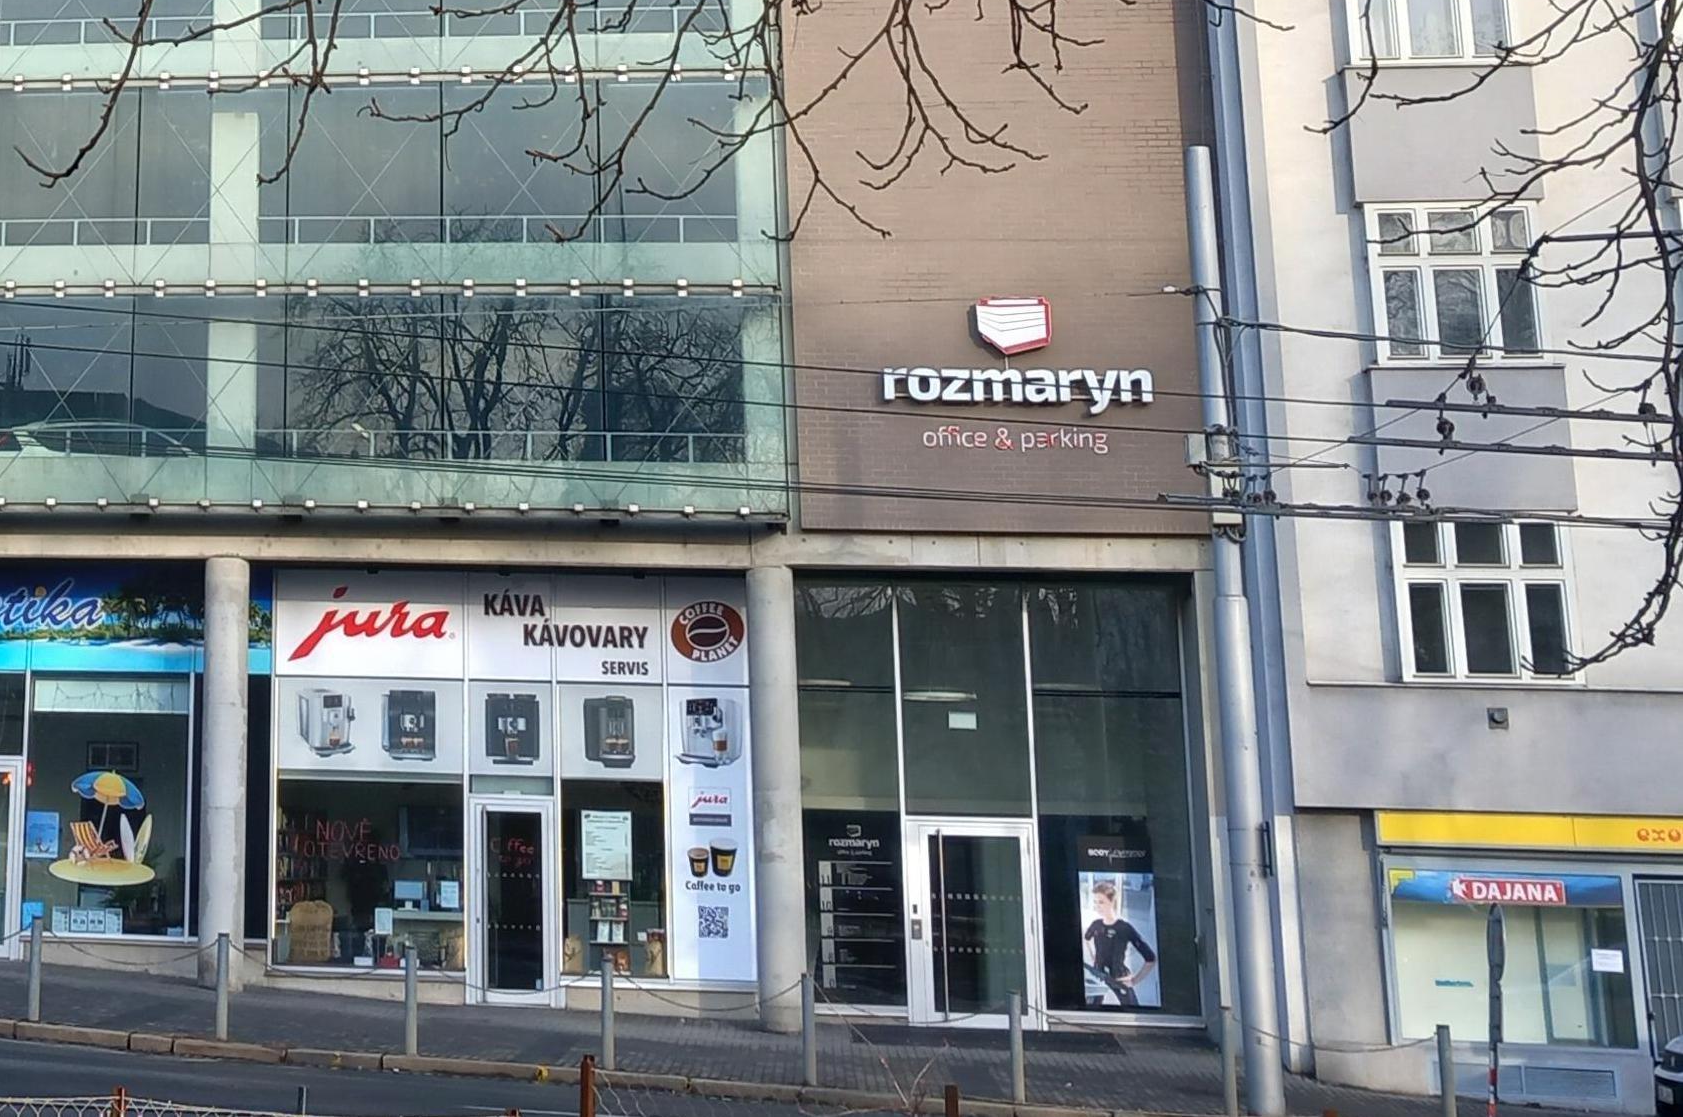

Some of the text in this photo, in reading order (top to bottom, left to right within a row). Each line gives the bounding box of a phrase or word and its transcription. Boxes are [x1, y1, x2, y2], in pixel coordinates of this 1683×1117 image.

[882, 367, 1154, 416] rozmaryn
[922, 425, 1109, 455] office & parking
[483, 588, 546, 618] KÁVA
[679, 602, 725, 625] COFFEE
[288, 585, 450, 662] jura
[523, 617, 650, 649] KÁVOVARY
[691, 635, 739, 661] PLANET
[601, 660, 650, 676] SERVIS
[691, 790, 729, 809] jura
[828, 838, 880, 850] rozmaryn
[685, 880, 741, 895] Coffee to go
[1471, 882, 1558, 902] DAJANA
